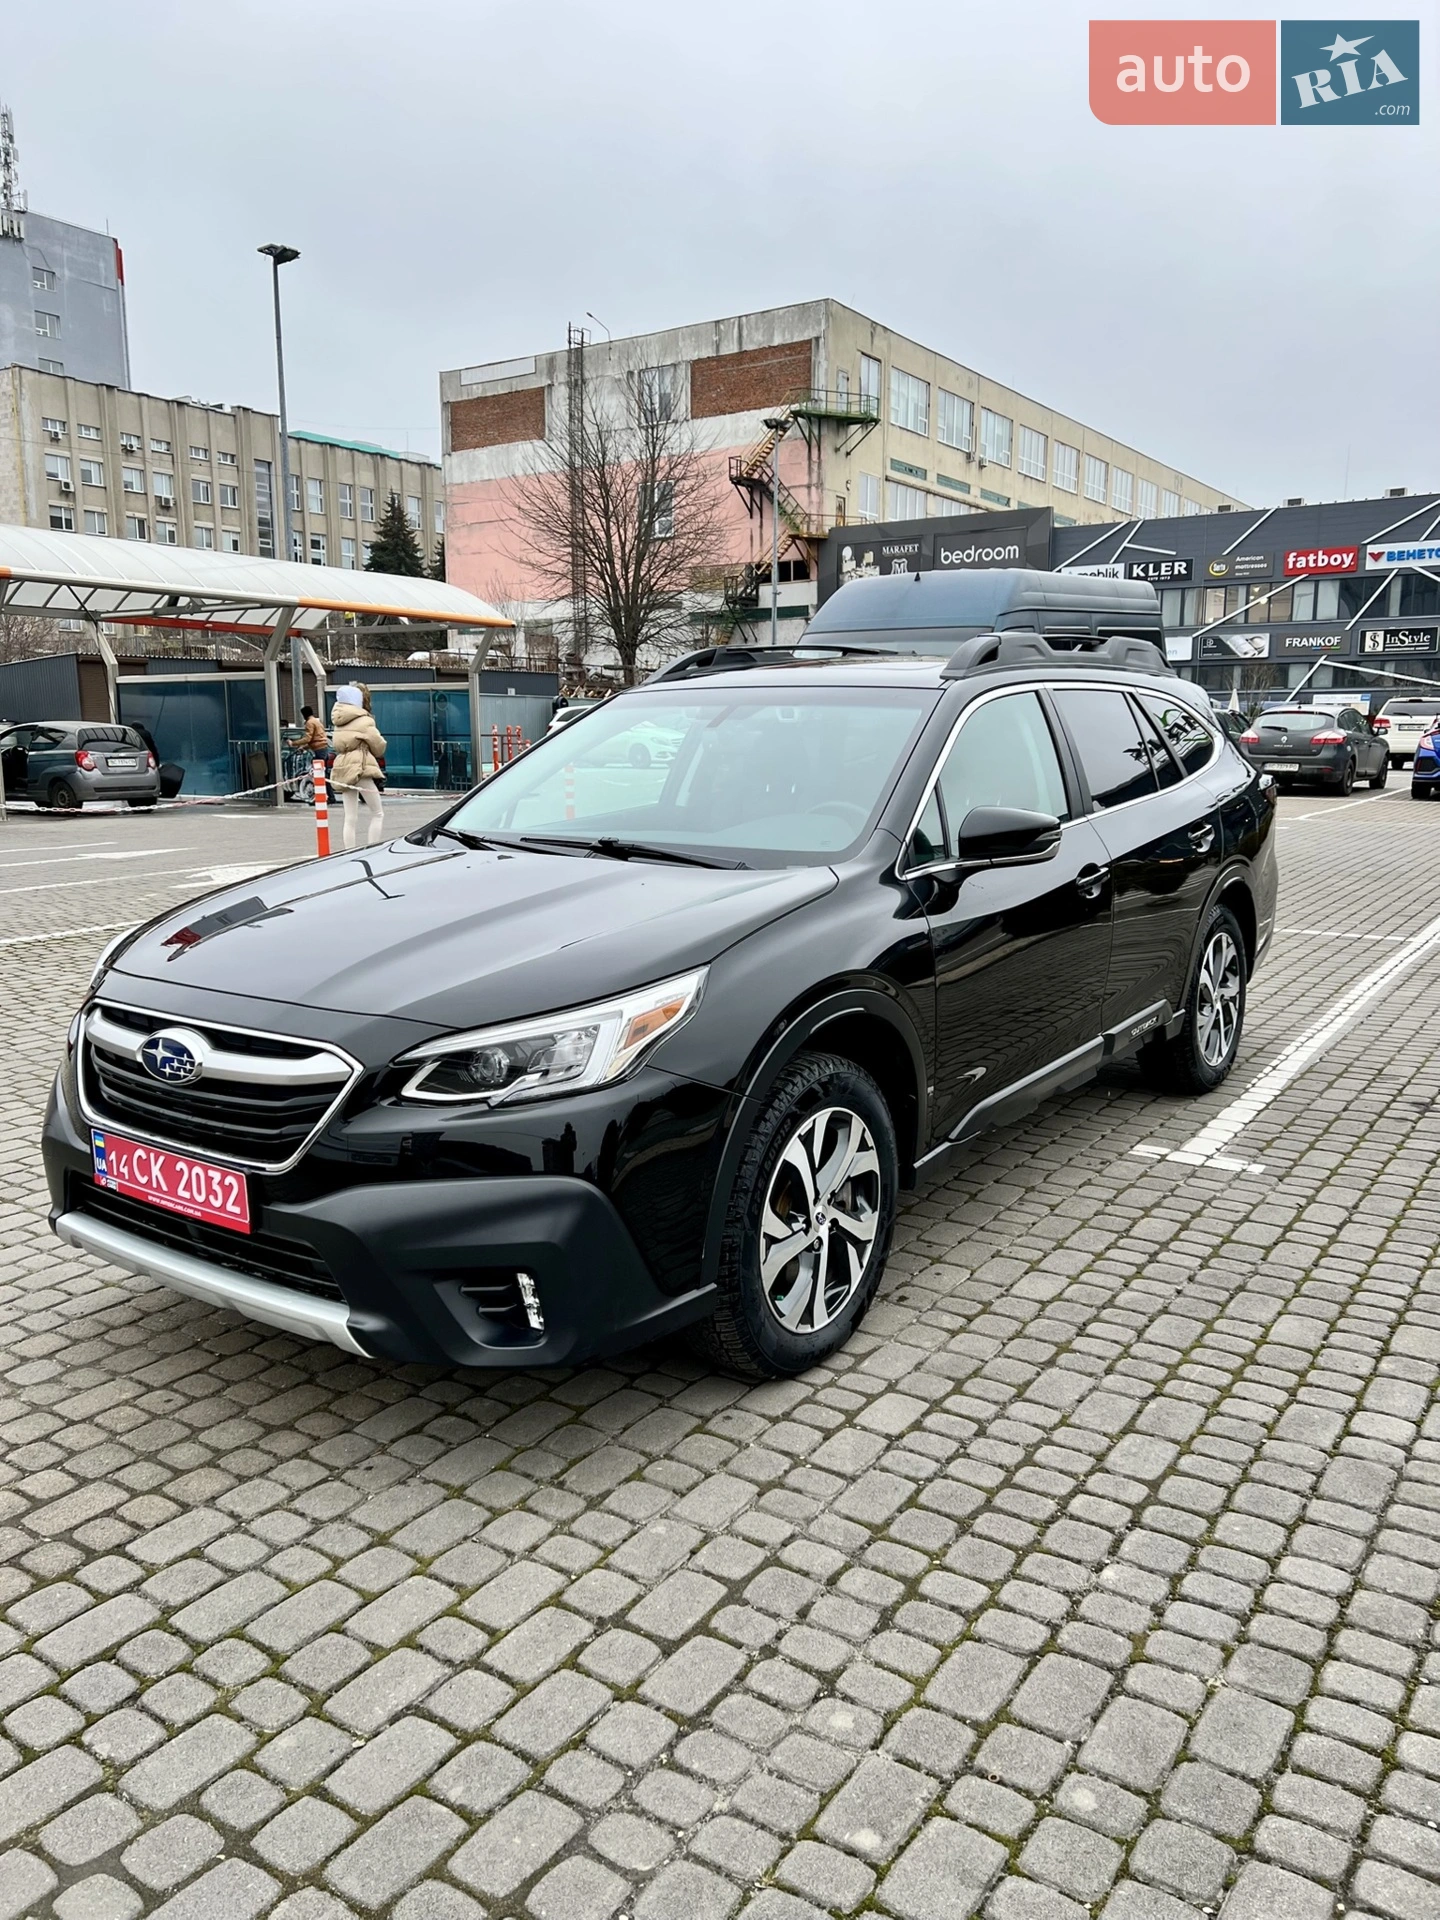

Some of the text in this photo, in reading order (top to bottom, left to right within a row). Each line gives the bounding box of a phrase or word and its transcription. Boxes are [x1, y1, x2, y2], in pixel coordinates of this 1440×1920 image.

[882, 544, 919, 554] MARAFET
[940, 545, 1019, 564] bedroom
[1132, 561, 1188, 577] KLER
[1285, 636, 1342, 648] FRANKOF
[1386, 630, 1430, 646] InStyle
[96, 1157, 107, 1172] UA
[175, 1161, 241, 1214] 2032
